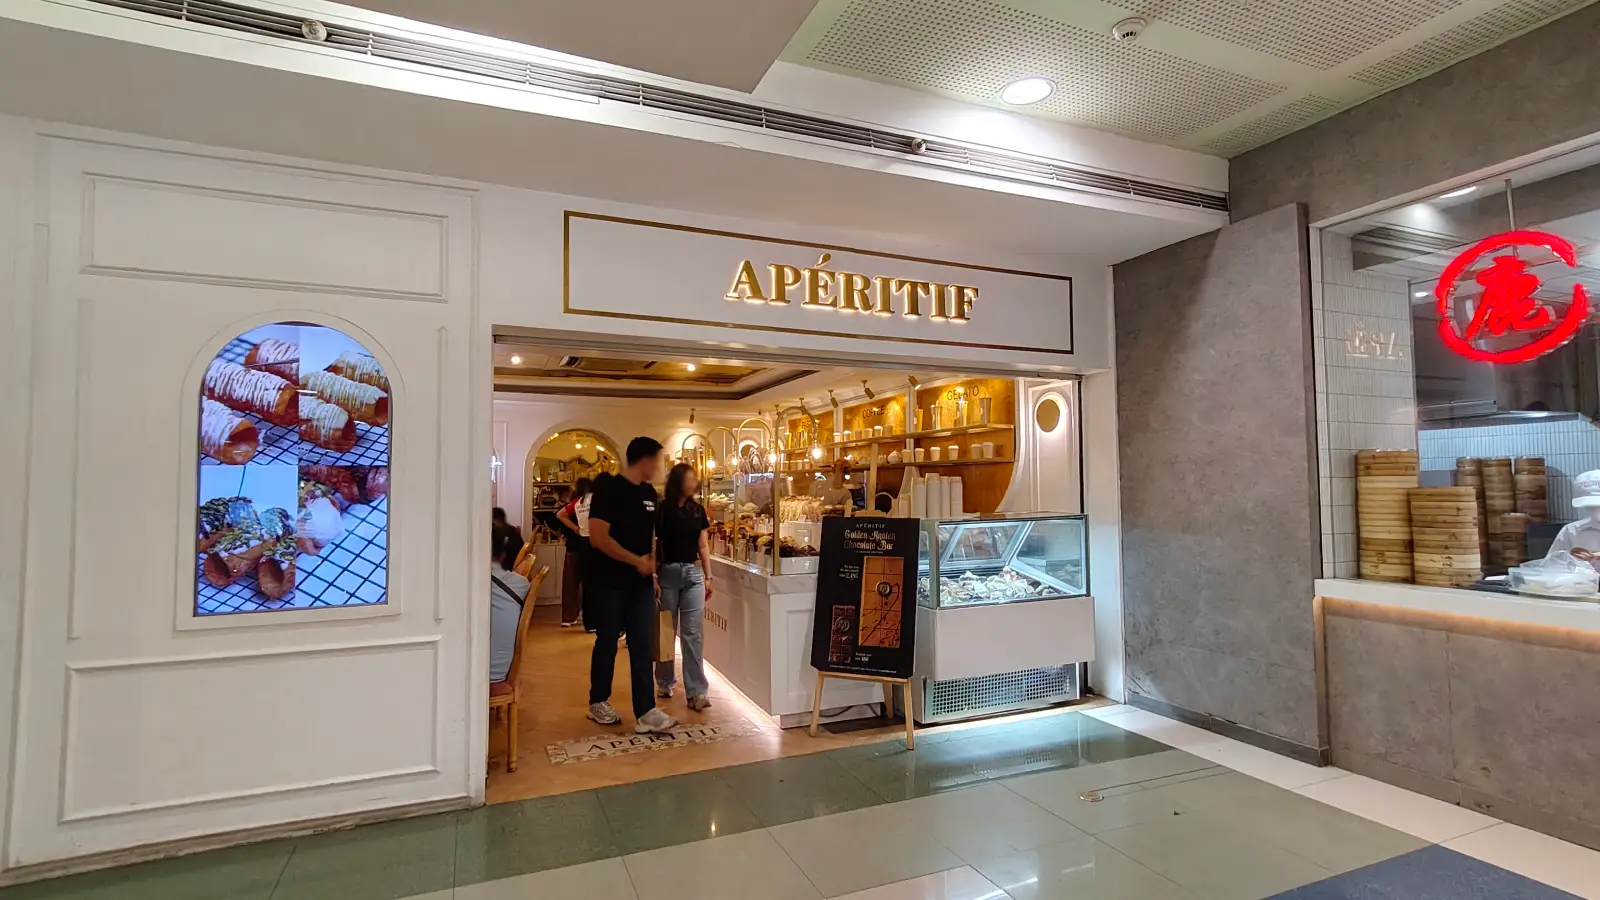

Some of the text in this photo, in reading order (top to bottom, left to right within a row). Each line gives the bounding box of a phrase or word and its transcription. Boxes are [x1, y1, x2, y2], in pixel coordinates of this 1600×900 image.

[725, 252, 979, 323] APÉRITIF
[946, 385, 980, 401] GELATO
[862, 404, 885, 419] COFFEE
[844, 529, 868, 540] Golden
[843, 540, 894, 551] Chocolate Bar
[587, 726, 723, 753] APÉRITIF
